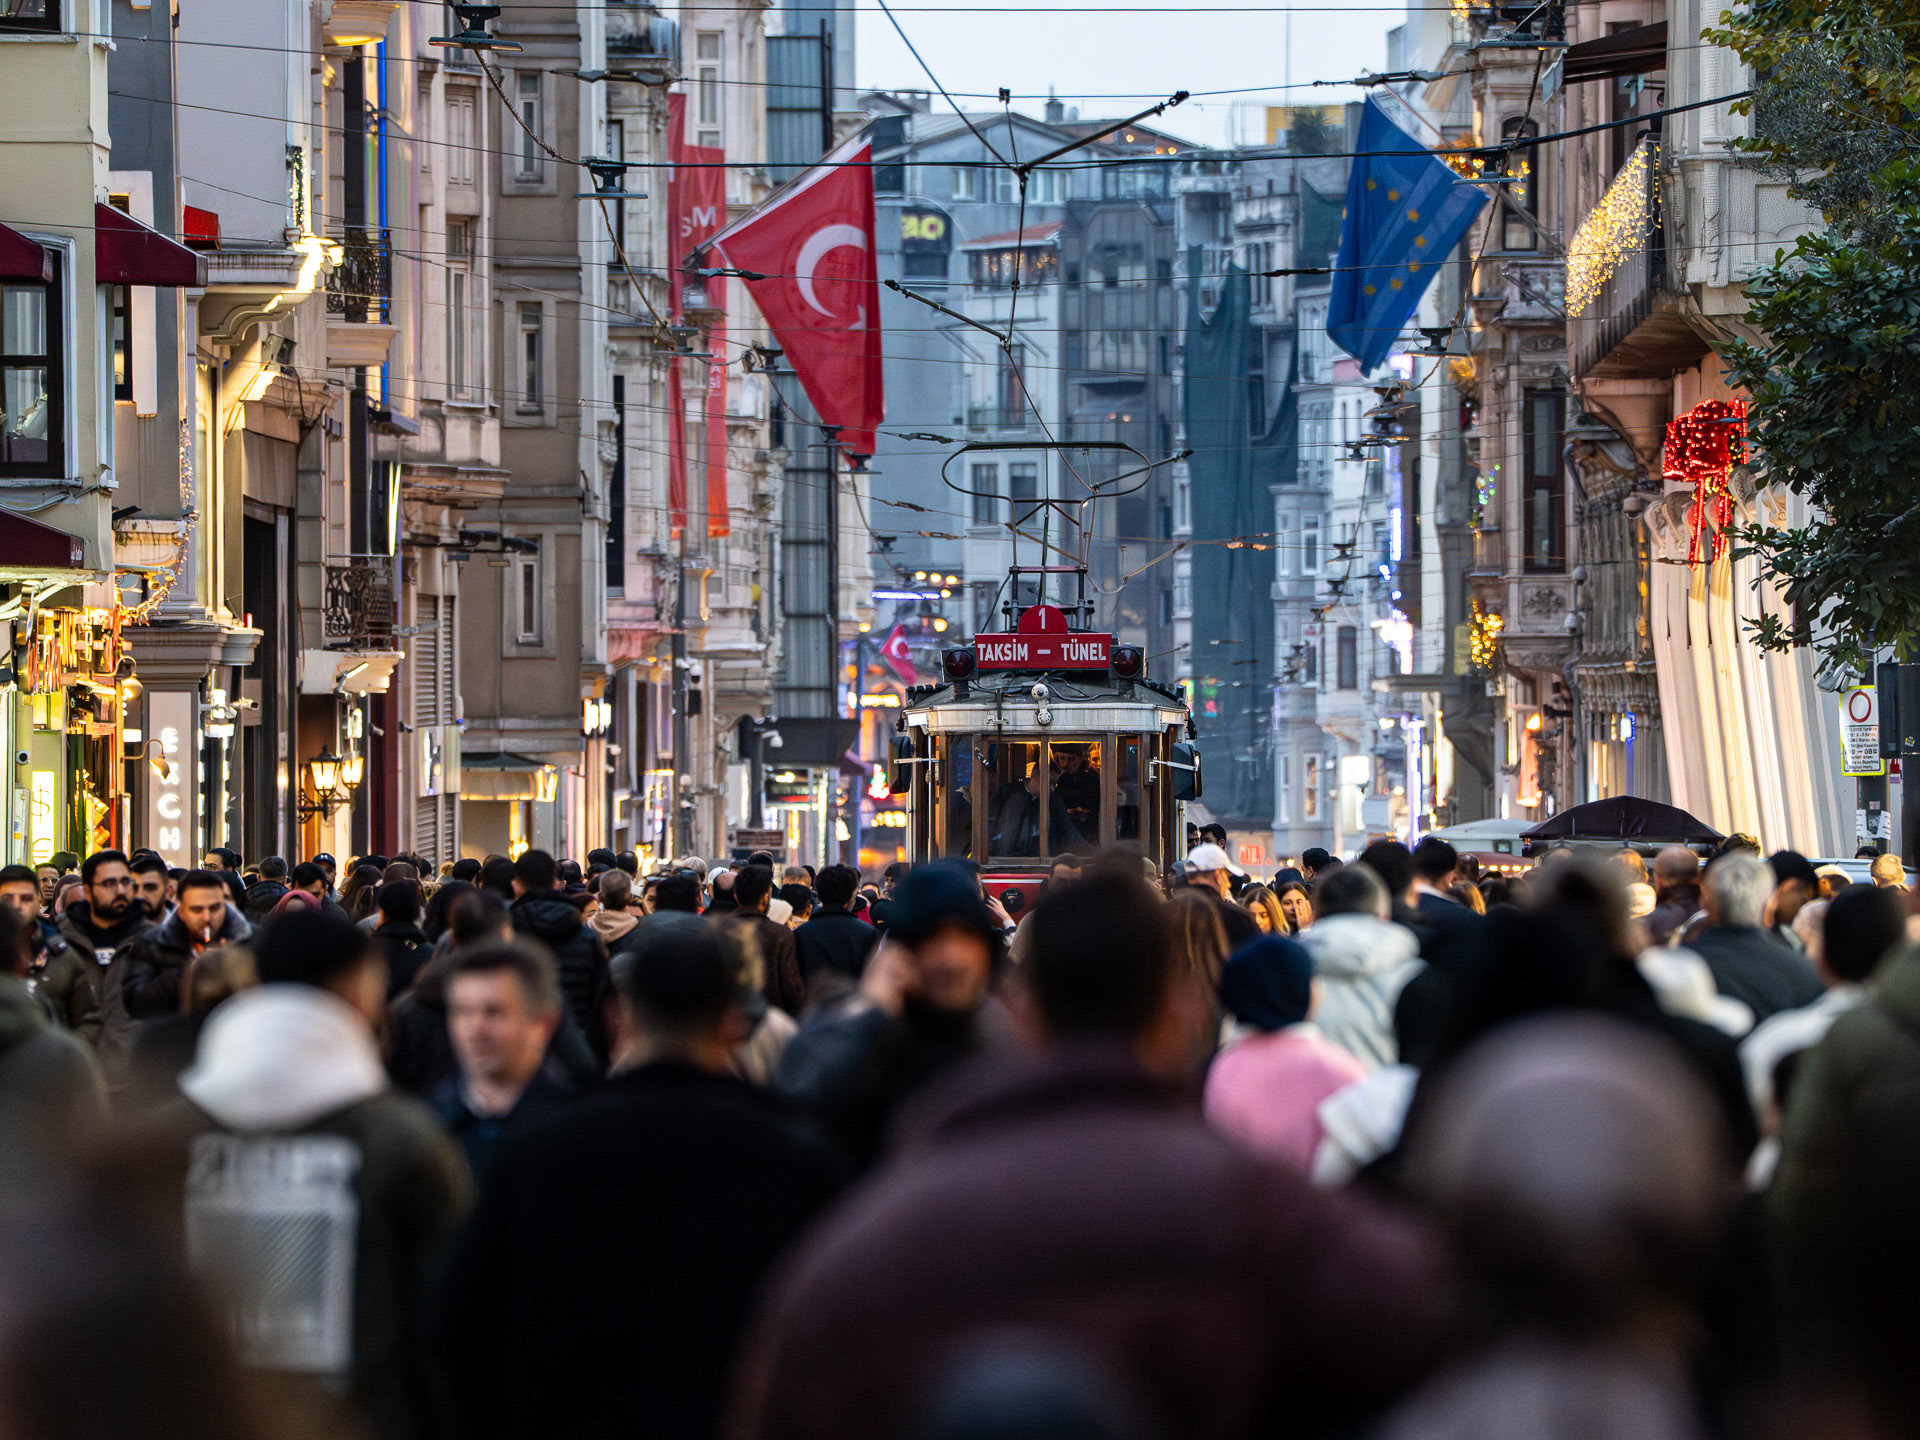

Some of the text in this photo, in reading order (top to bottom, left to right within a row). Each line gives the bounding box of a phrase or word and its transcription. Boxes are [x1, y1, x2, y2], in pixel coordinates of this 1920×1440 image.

[1038, 607, 1046, 630] 1
[977, 638, 1028, 661] TAKSİM
[1061, 638, 1107, 661] TÜNEL
[157, 727, 181, 868] EXCH
